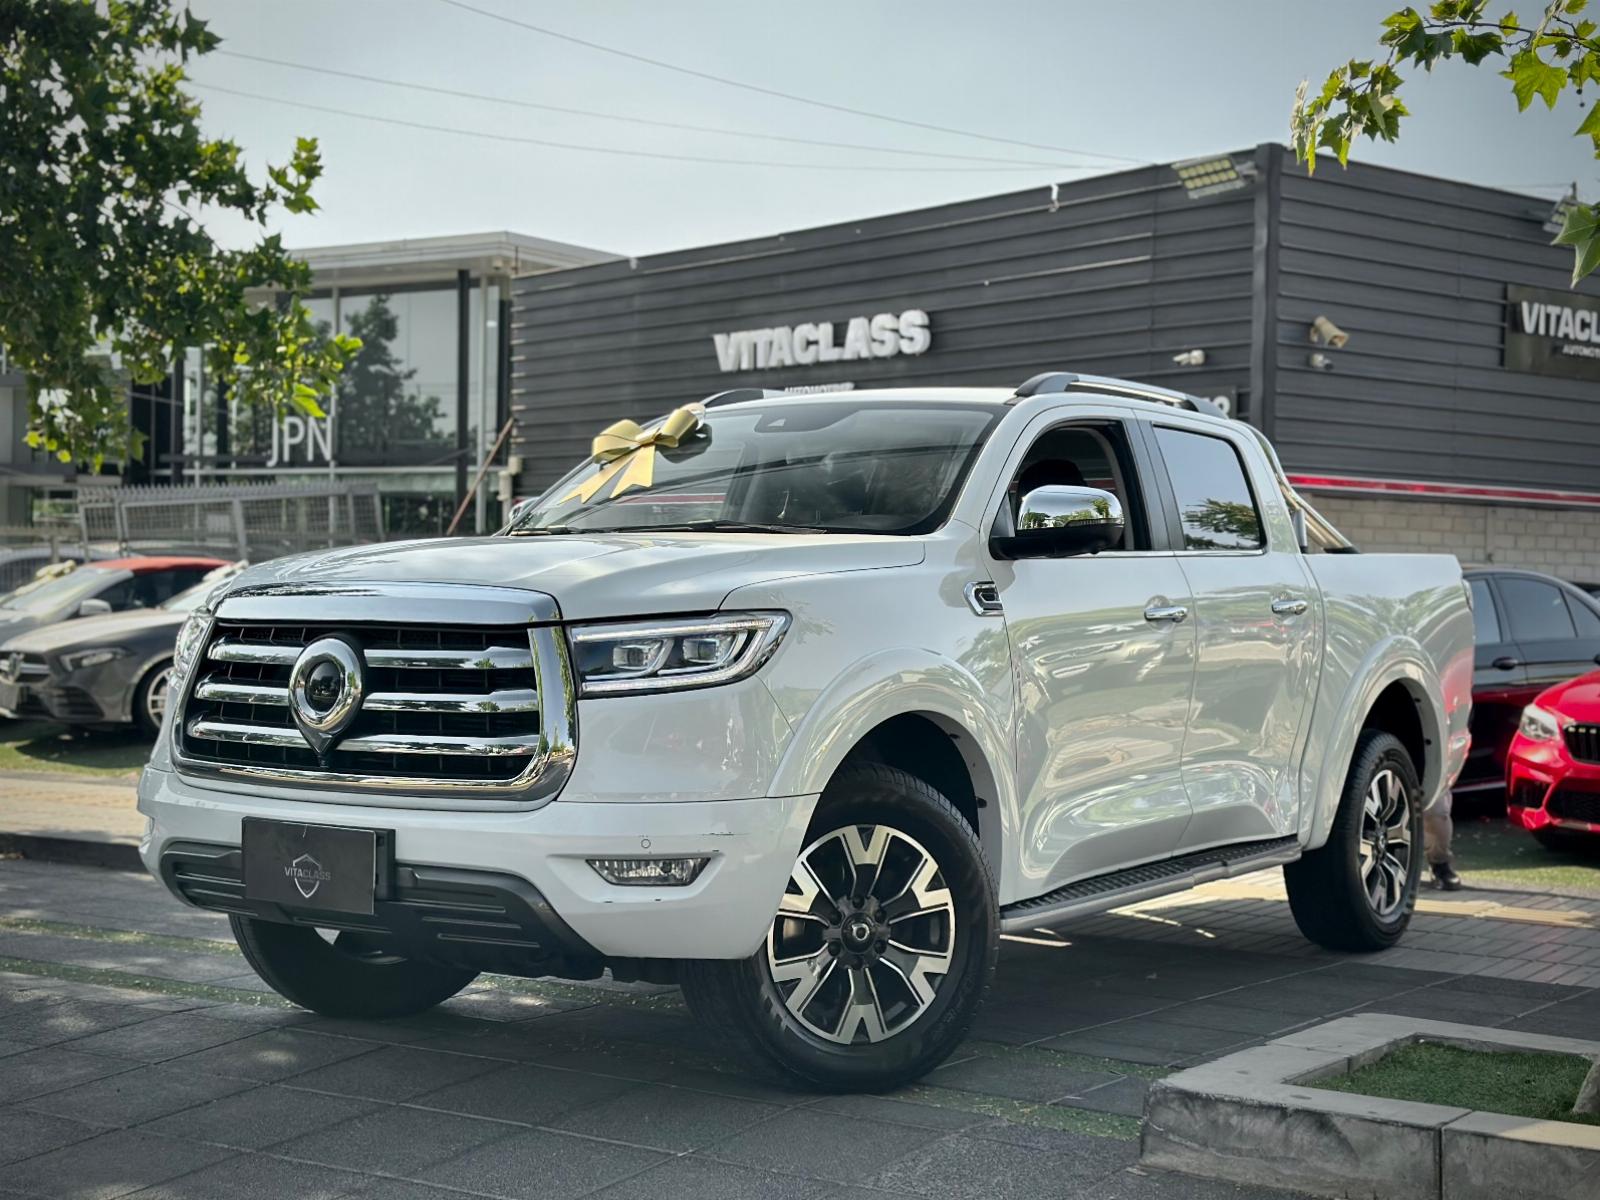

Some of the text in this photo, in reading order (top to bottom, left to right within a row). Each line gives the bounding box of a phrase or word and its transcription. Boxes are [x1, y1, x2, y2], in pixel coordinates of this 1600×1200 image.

[713, 309, 931, 372] VITACLASS
[1521, 301, 1600, 343] VITACL
[1562, 344, 1600, 359] AUTOMOT
[266, 415, 332, 467] JPN
[284, 866, 331, 881] VITACLASS
